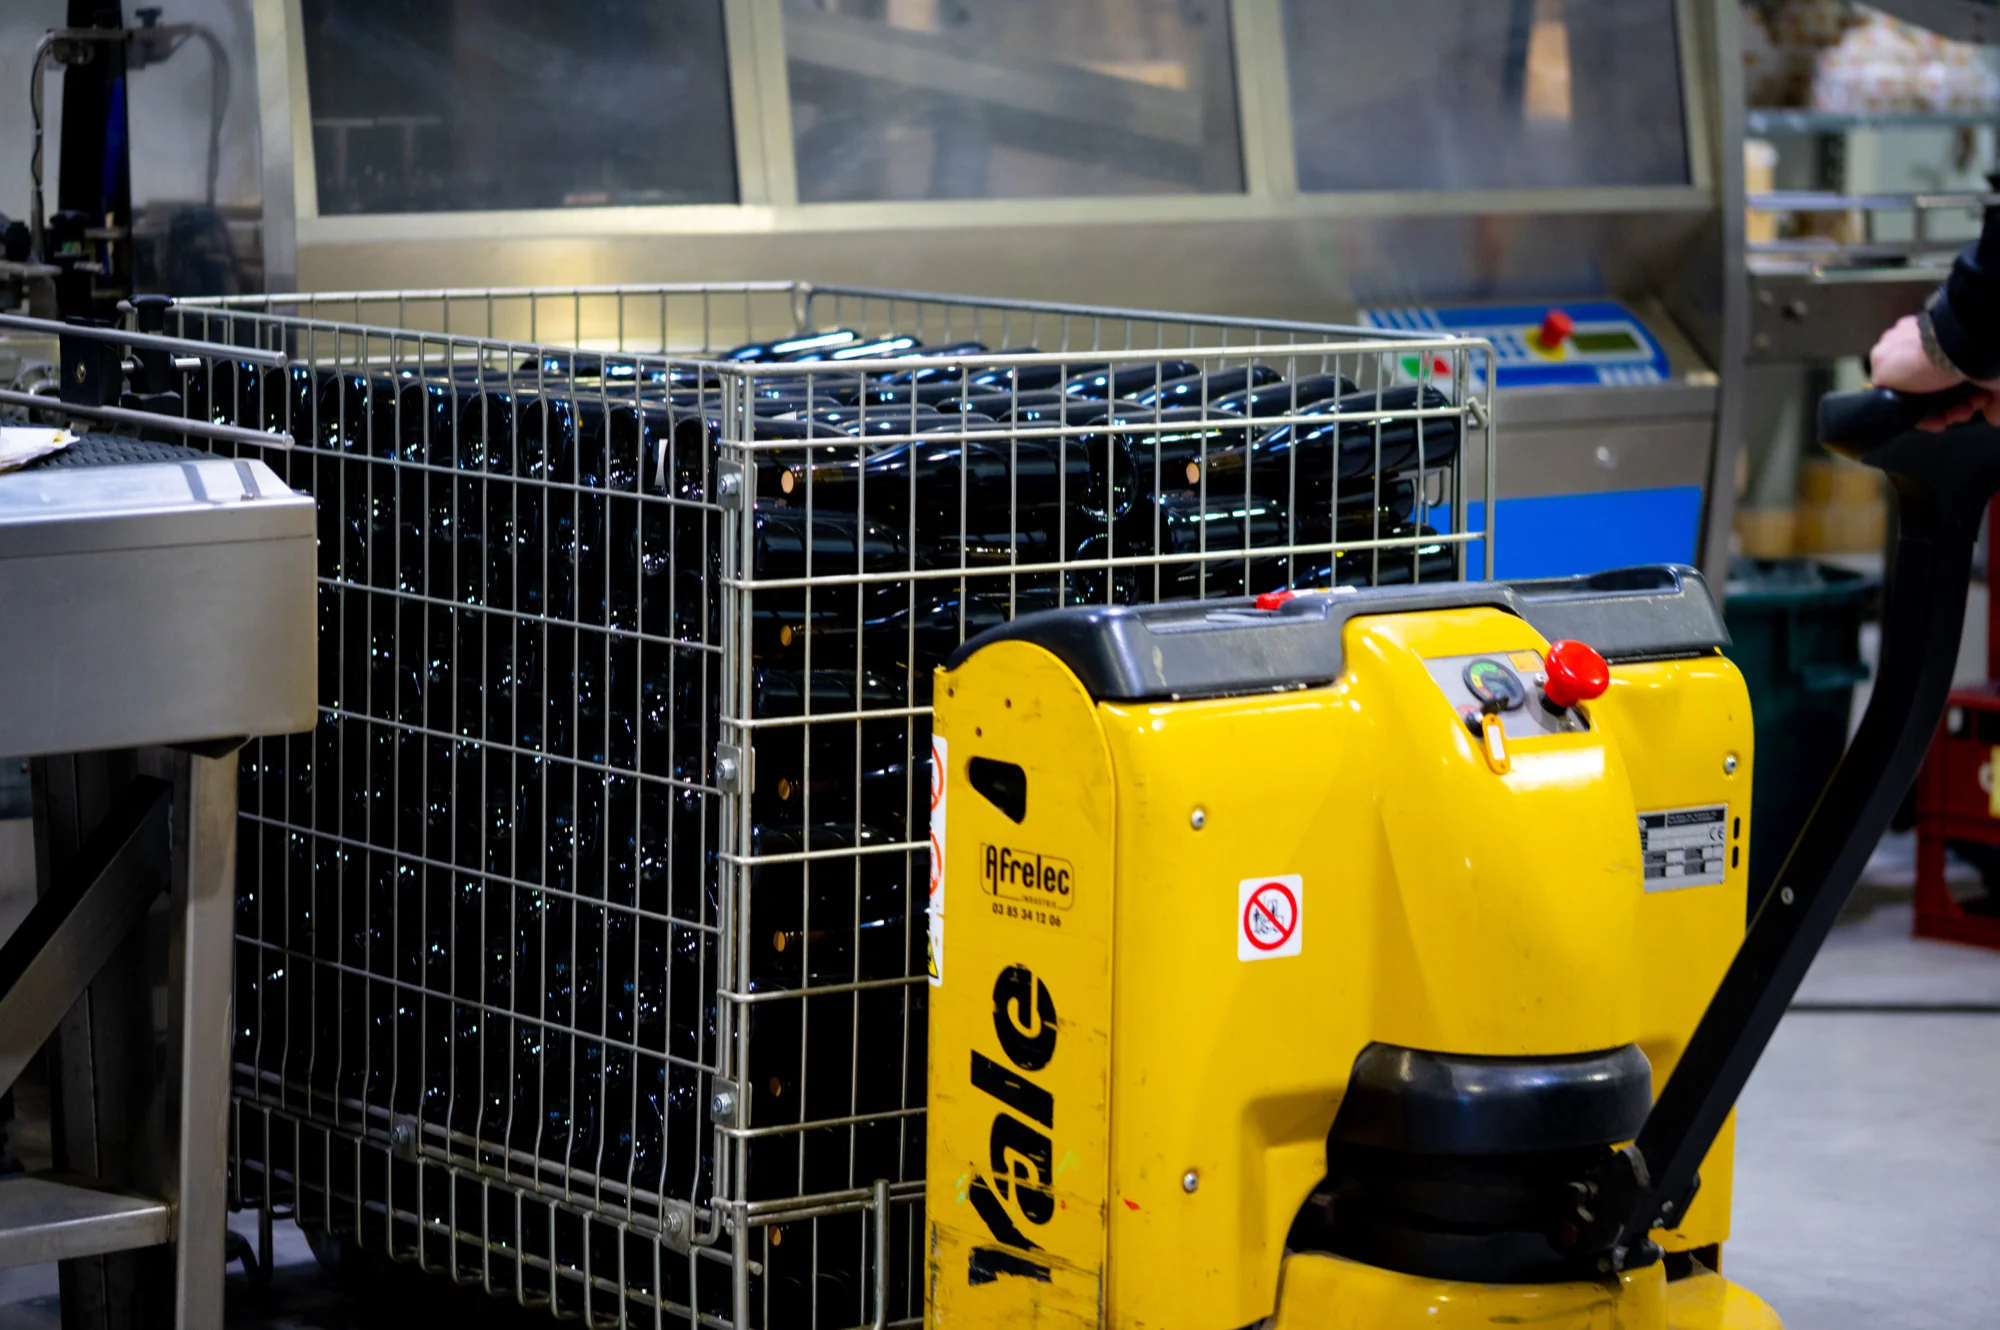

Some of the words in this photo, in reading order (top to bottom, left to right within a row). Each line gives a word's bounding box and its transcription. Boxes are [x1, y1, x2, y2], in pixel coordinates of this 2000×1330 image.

[986, 844, 1069, 895] Afrelec
[992, 902, 1004, 915] 03
[1007, 904, 1018, 918] 85
[1021, 907, 1033, 921] 34
[1035, 910, 1046, 924] 12
[968, 962, 1058, 1286] Yale
